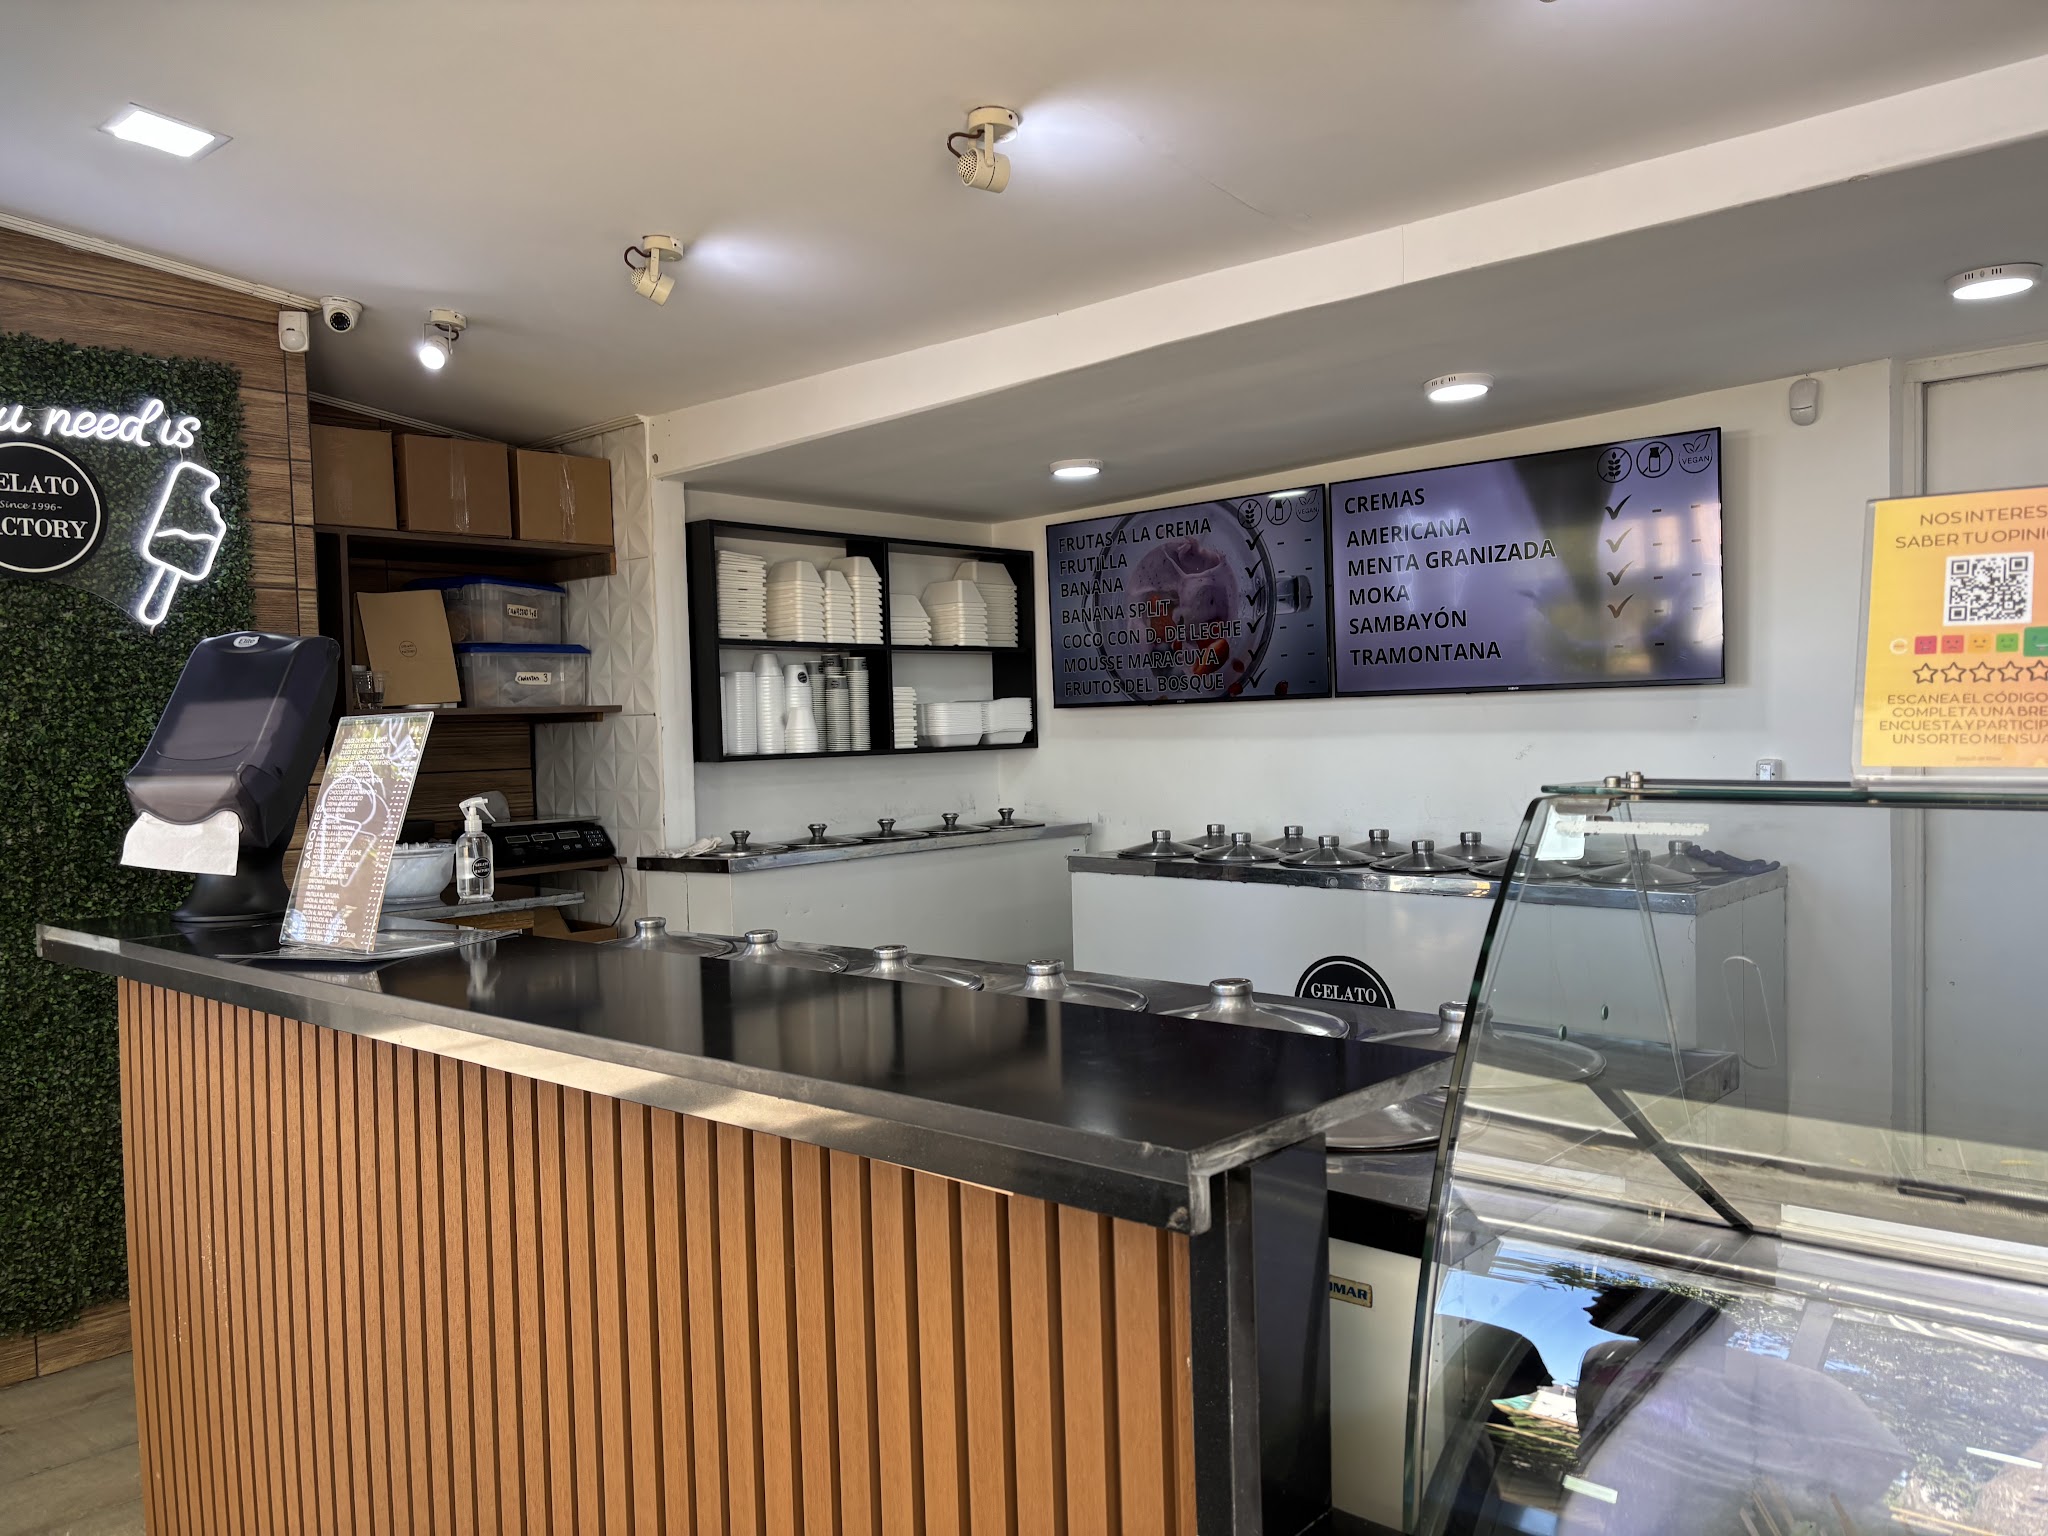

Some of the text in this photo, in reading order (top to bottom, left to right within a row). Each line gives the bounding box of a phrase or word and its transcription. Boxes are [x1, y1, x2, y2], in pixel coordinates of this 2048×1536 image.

[43, 398, 164, 446] need
[160, 416, 201, 448] is
[1681, 455, 1710, 464] VEGAN
[1297, 506, 1318, 516] VEGAN
[1344, 487, 1426, 515] CREMAS
[0, 517, 88, 540] CTORY
[1920, 511, 1961, 526] NOS
[1058, 517, 1212, 553] FRUTAS A LA CREMA
[1346, 517, 1471, 548] AMERICANA
[1895, 526, 2048, 549] SABER TU OPINI
[1059, 553, 1128, 575] FRUTILLA
[1348, 539, 1557, 577] MENTA GRANIZADA
[1060, 577, 1124, 598] BANANA
[1349, 584, 1410, 606] MOKA
[1062, 599, 1171, 624] BANANA SPLIT
[1349, 606, 1467, 635] SAMBAYÓN
[1063, 620, 1242, 650] COCO CON D. DE LECHE
[1063, 647, 1220, 673] MOUSSE MARACUYA
[1349, 641, 1502, 666] TRAMONTANA
[543, 673, 548, 682] 3
[1064, 672, 1225, 697] FRUTOS DEL BOSQUE
[1887, 694, 1960, 705] ESCANEA
[1963, 693, 1981, 704] EL
[1892, 707, 1979, 718] COMPLETA
[1980, 706, 2016, 717] UNA
[1879, 720, 1963, 731] ENCUESTA
[1963, 720, 1973, 730] Y
[1892, 734, 1914, 744] UN
[1917, 733, 1982, 744] SORTEO
[303, 804, 323, 869] SABORES
[1310, 982, 1378, 1004] GELATO
